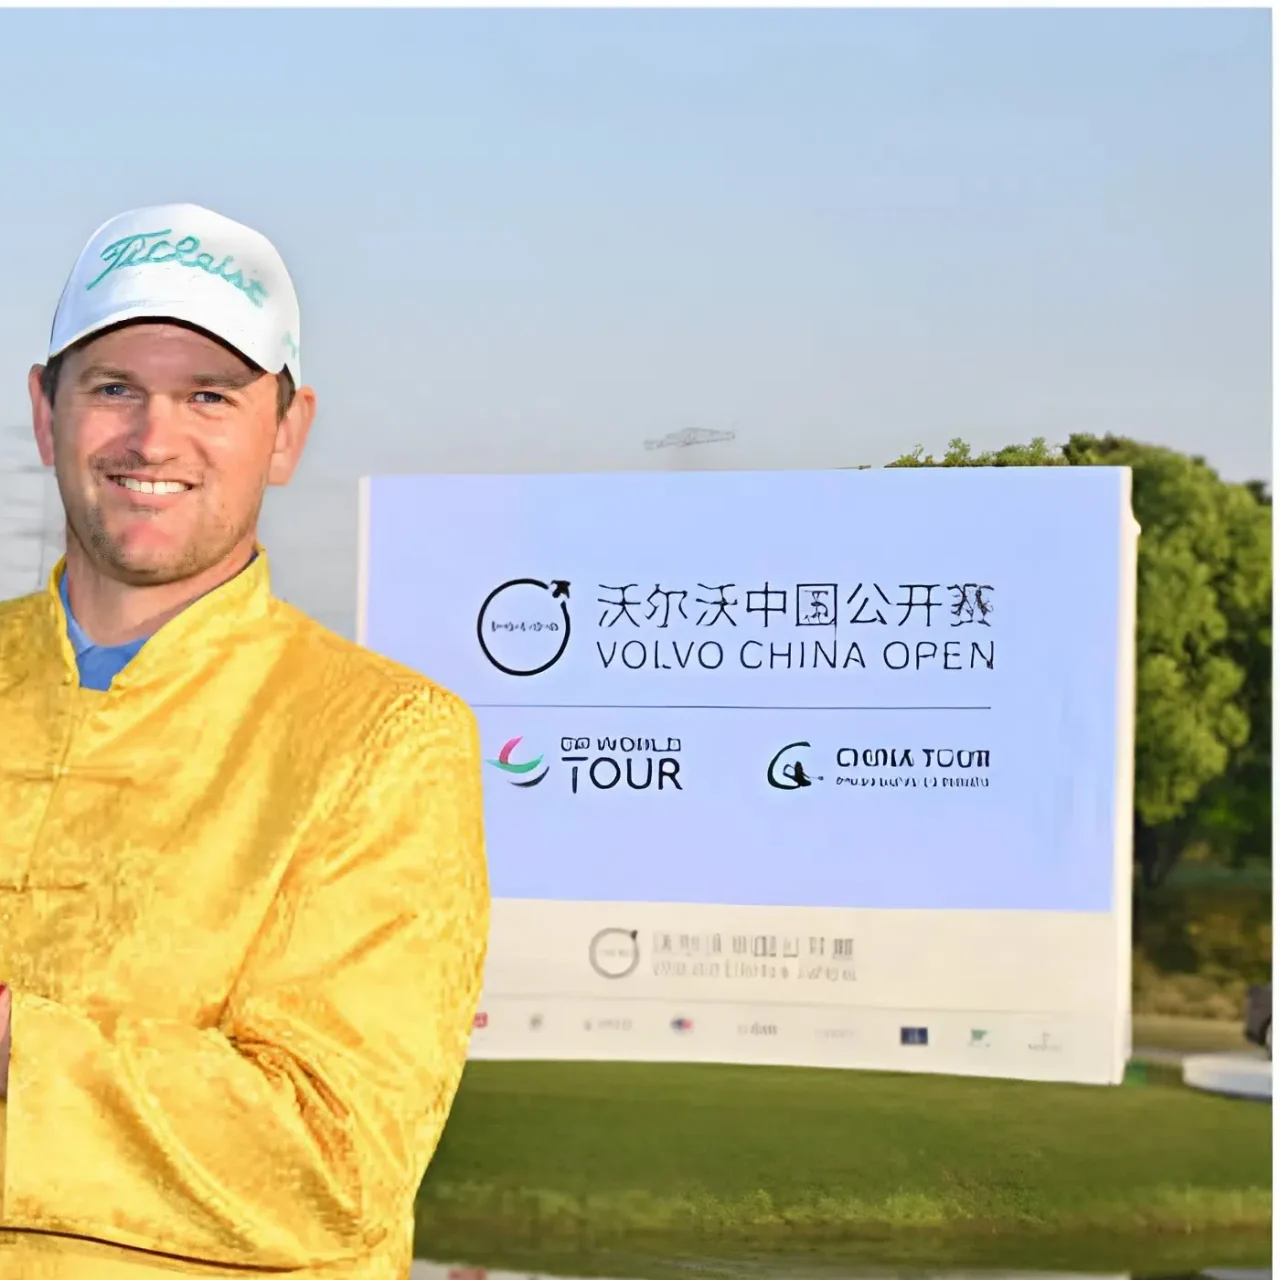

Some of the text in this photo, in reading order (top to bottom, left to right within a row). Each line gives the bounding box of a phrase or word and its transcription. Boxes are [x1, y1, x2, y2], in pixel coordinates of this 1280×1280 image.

[596, 640, 995, 670] VOLVO CHINA OPEN
[561, 757, 683, 794] TOUR
